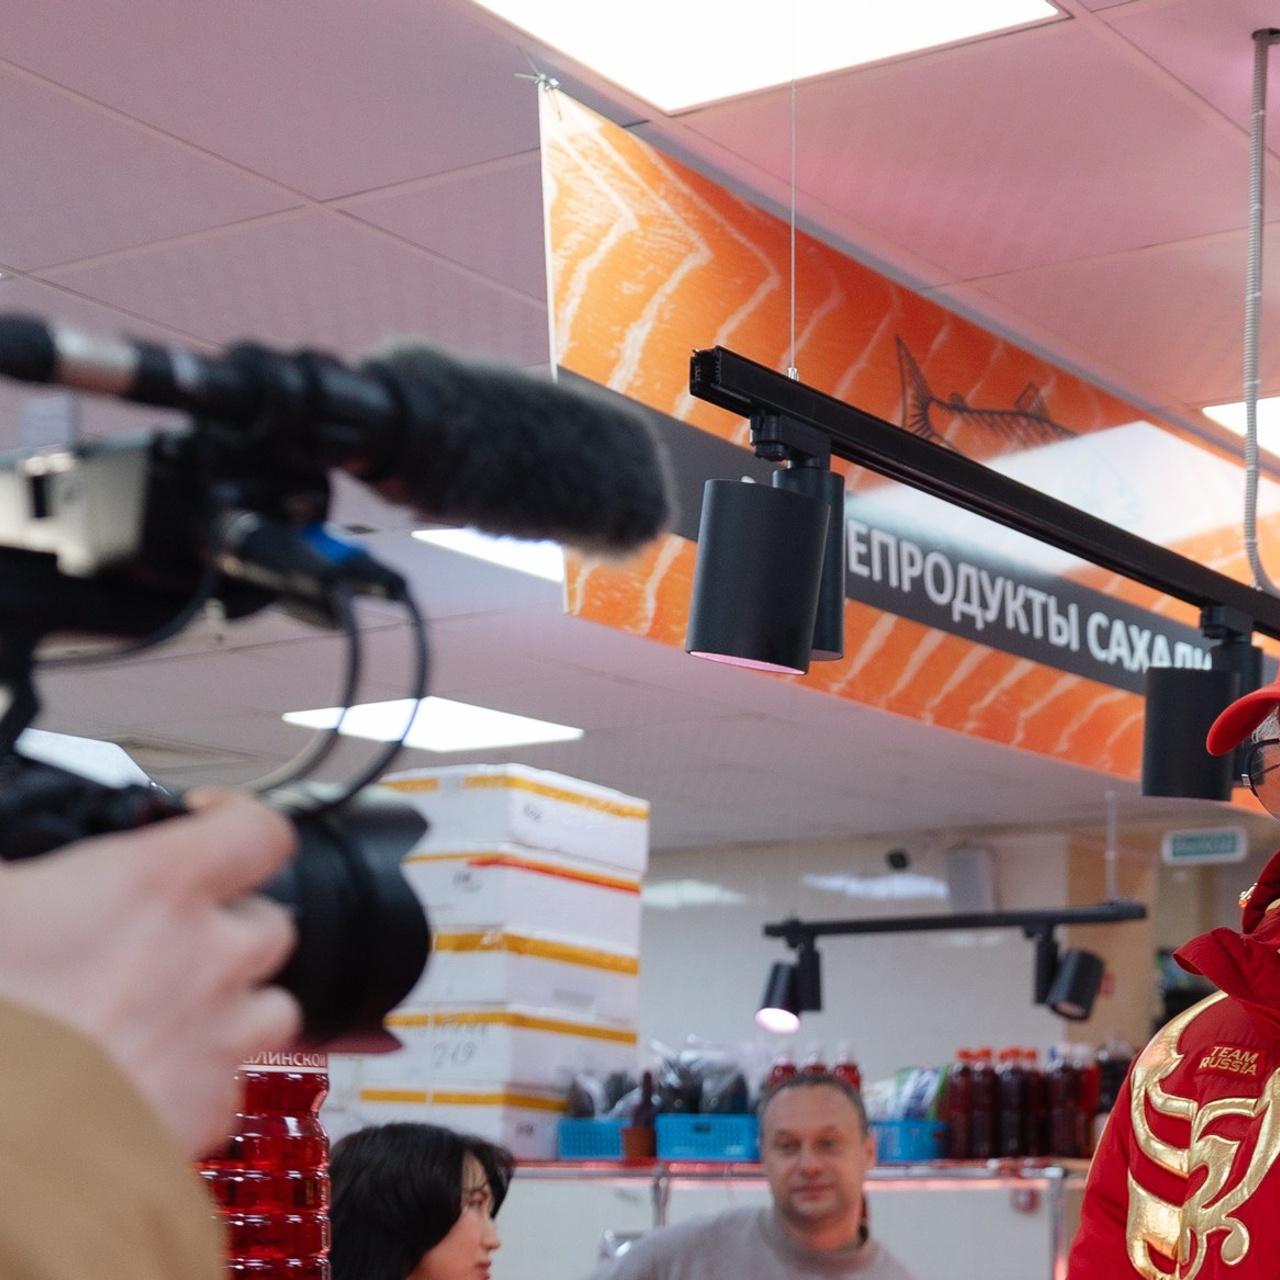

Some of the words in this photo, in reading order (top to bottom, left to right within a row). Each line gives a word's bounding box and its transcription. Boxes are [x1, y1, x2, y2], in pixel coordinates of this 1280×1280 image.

[847, 519, 1080, 652] ЕПРОДУКТЫ
[1210, 1046, 1260, 1064] TEAM
[1199, 1056, 1258, 1076] RUSSIA
